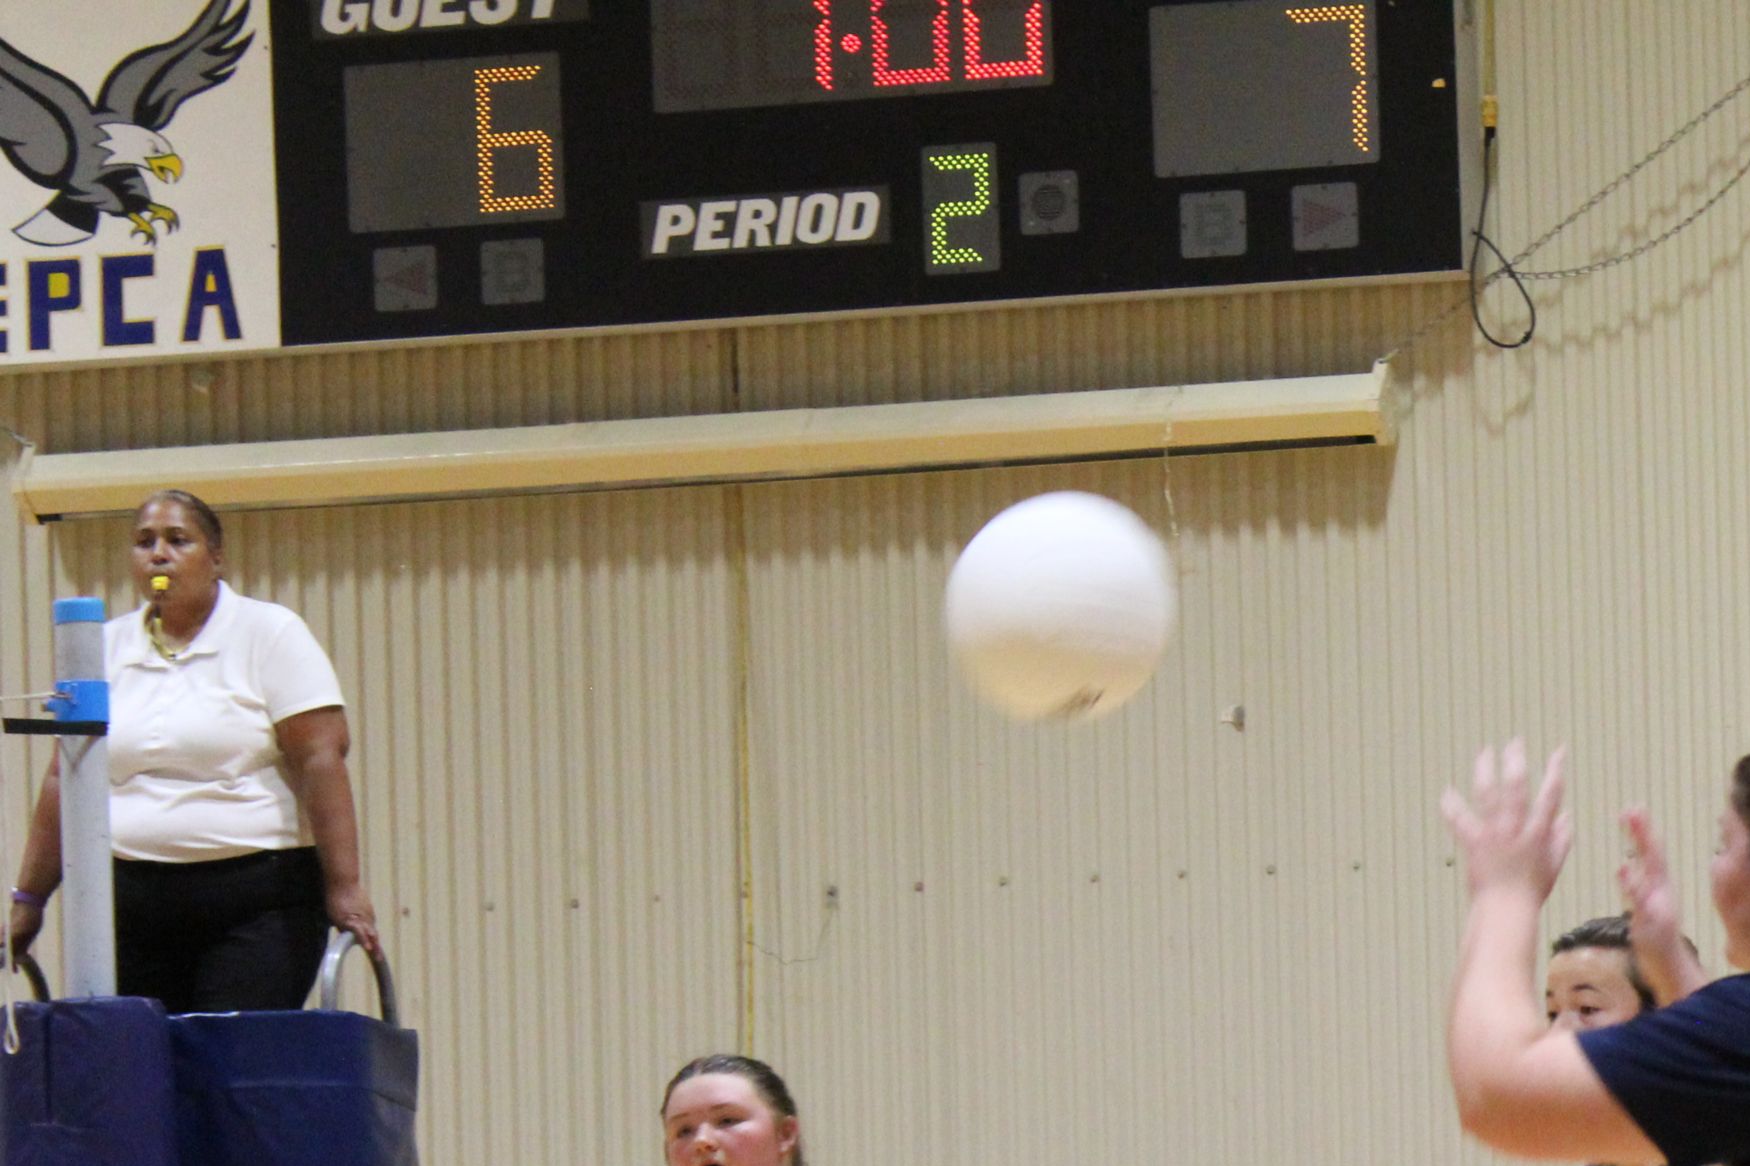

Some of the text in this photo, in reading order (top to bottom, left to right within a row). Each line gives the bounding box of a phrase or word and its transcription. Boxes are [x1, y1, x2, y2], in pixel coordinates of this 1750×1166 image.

[1285, 4, 1369, 152] 7
[474, 65, 555, 213] 6
[651, 191, 880, 254] PERIOD
[928, 152, 990, 264] 2
[0, 245, 243, 352] PCA
